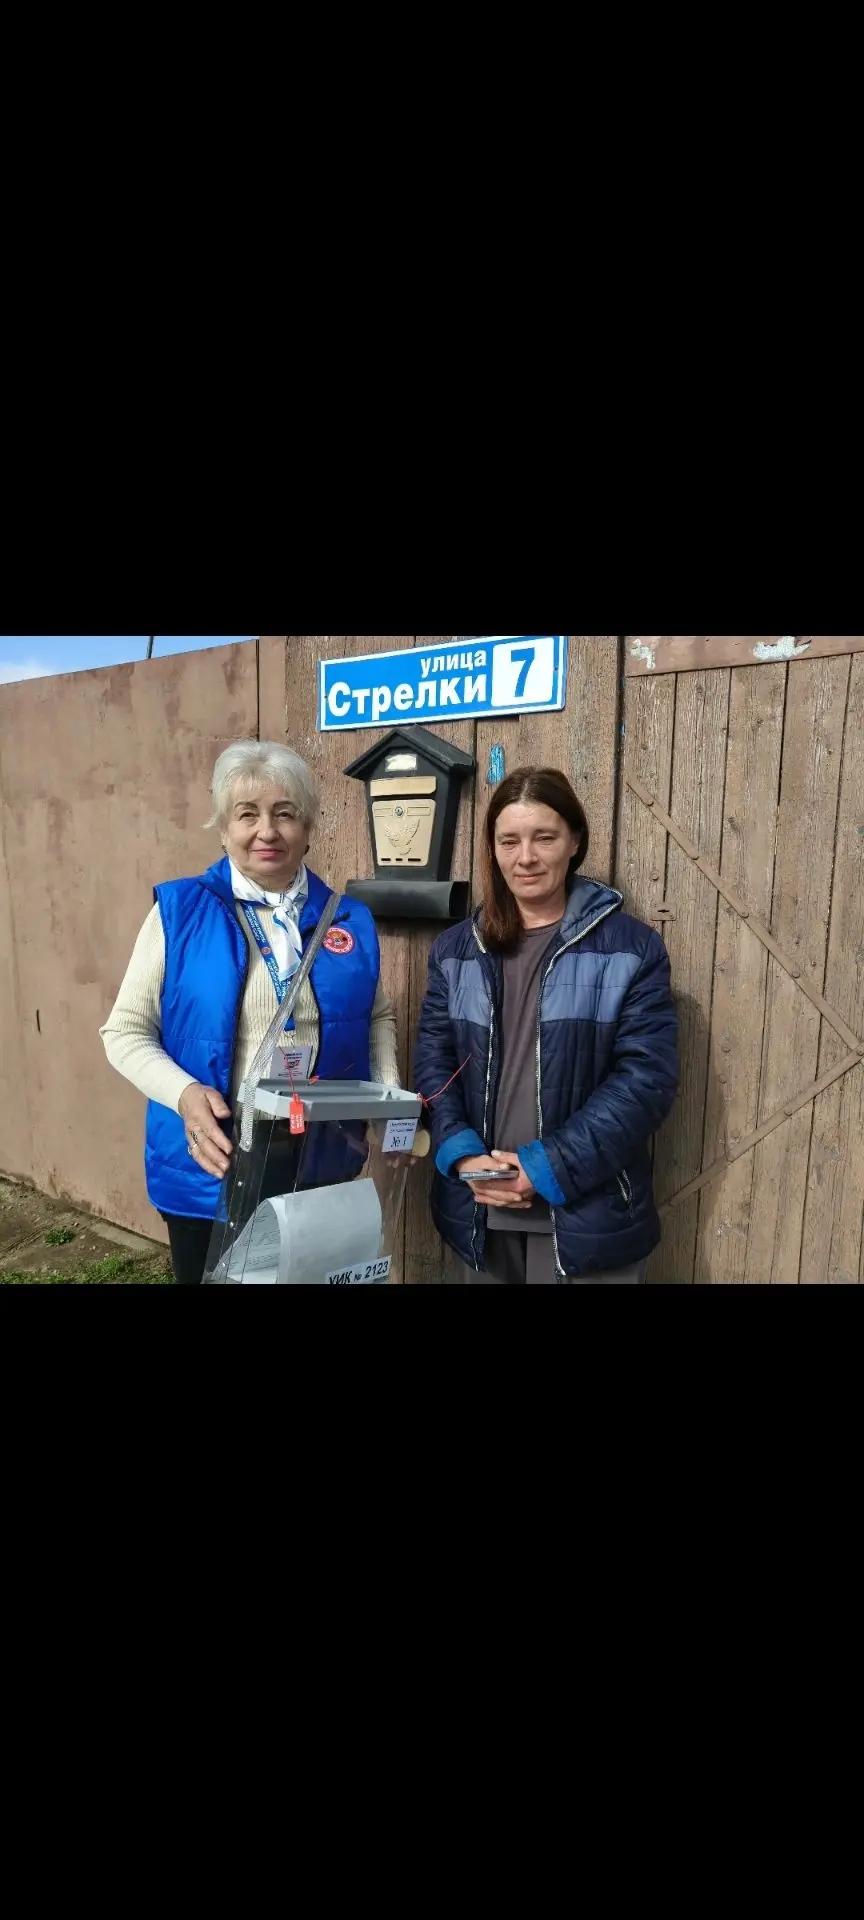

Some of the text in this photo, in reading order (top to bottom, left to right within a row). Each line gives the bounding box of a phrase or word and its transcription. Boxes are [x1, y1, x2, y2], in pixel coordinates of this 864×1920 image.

[420, 650, 487, 678] улица
[510, 647, 536, 698] 7
[327, 674, 487, 721] Стрелки
[364, 1260, 389, 1279] 2123
